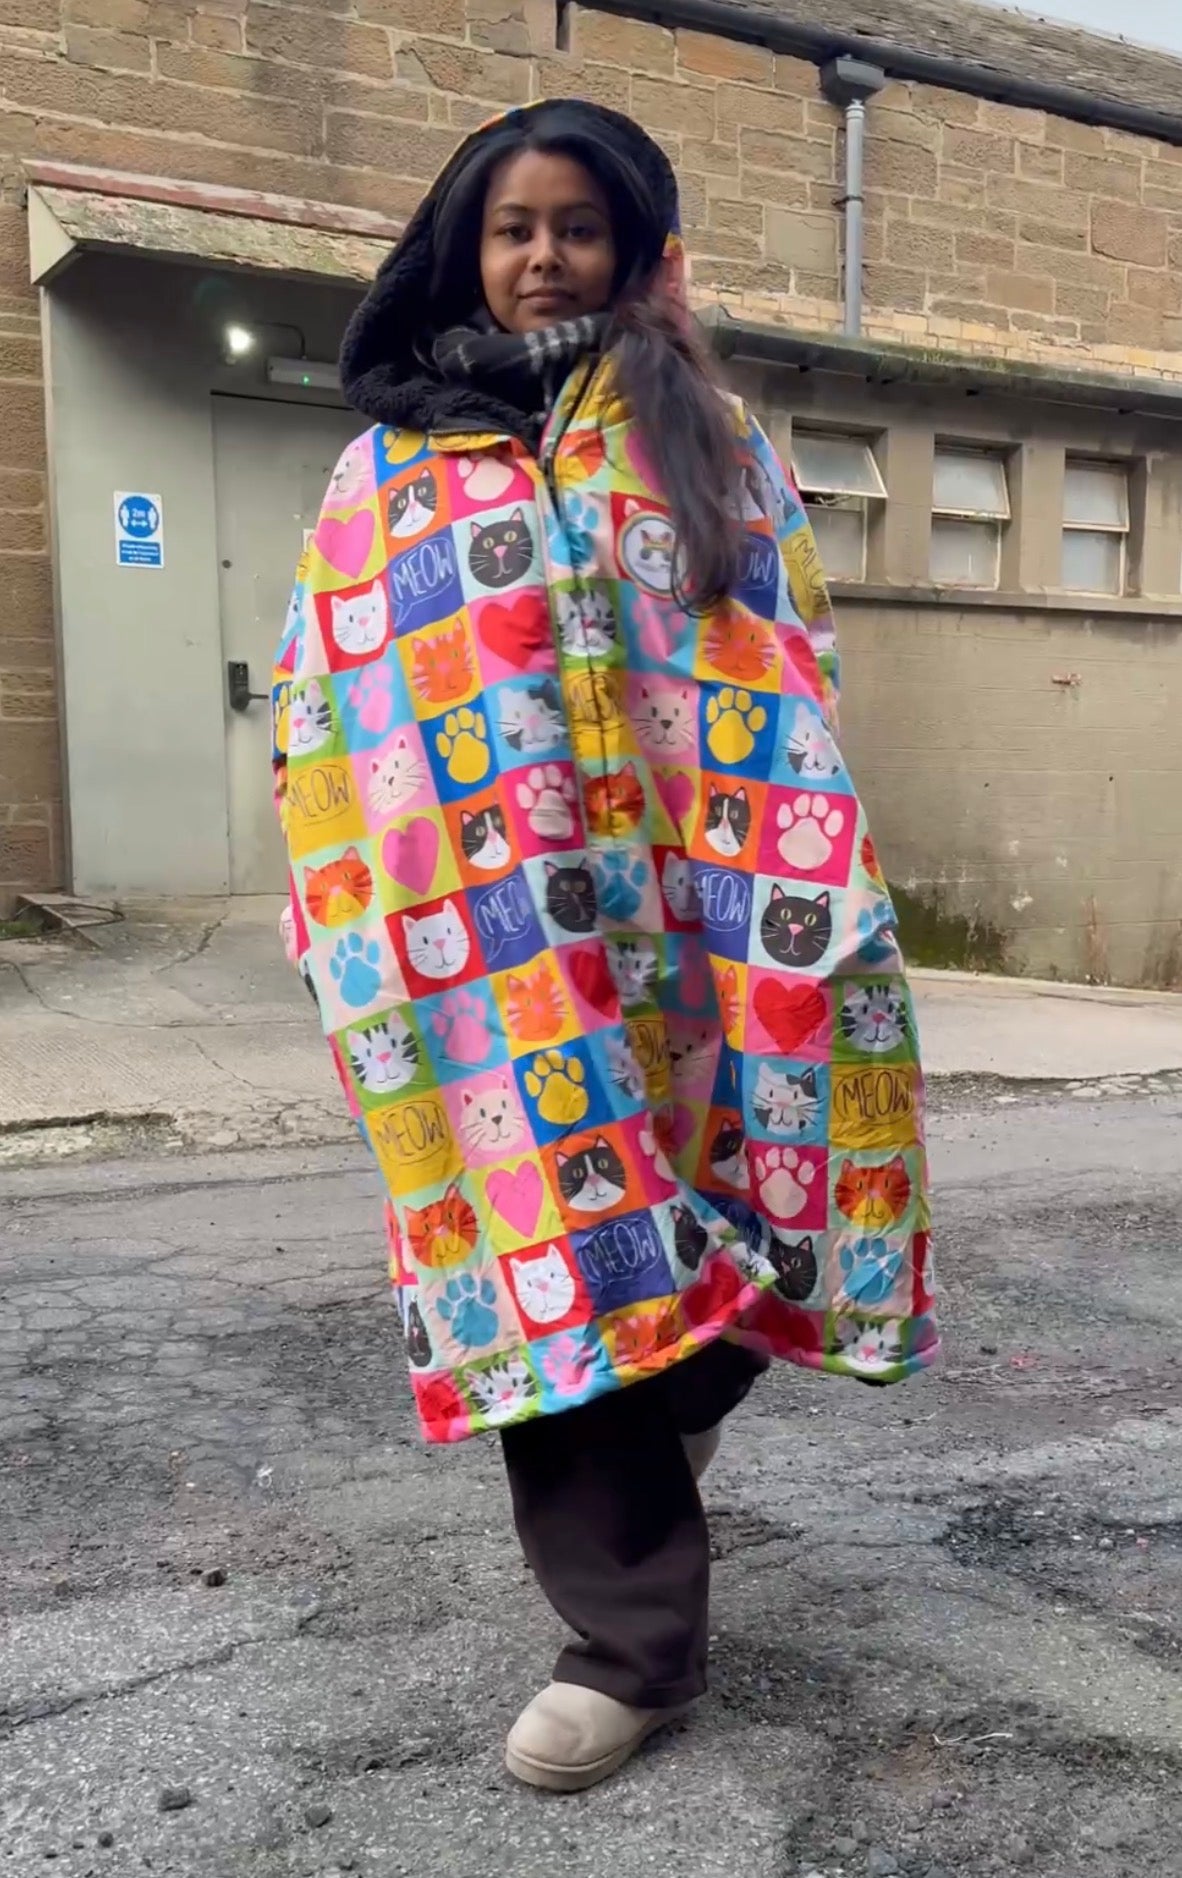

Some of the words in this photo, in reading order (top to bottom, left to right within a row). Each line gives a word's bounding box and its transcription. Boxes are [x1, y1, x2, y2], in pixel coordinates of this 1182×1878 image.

[393, 543, 453, 600] MEOW
[842, 1071, 910, 1118] MEOW
[377, 1105, 445, 1157] MEOW
[585, 1223, 656, 1276] MEOW
